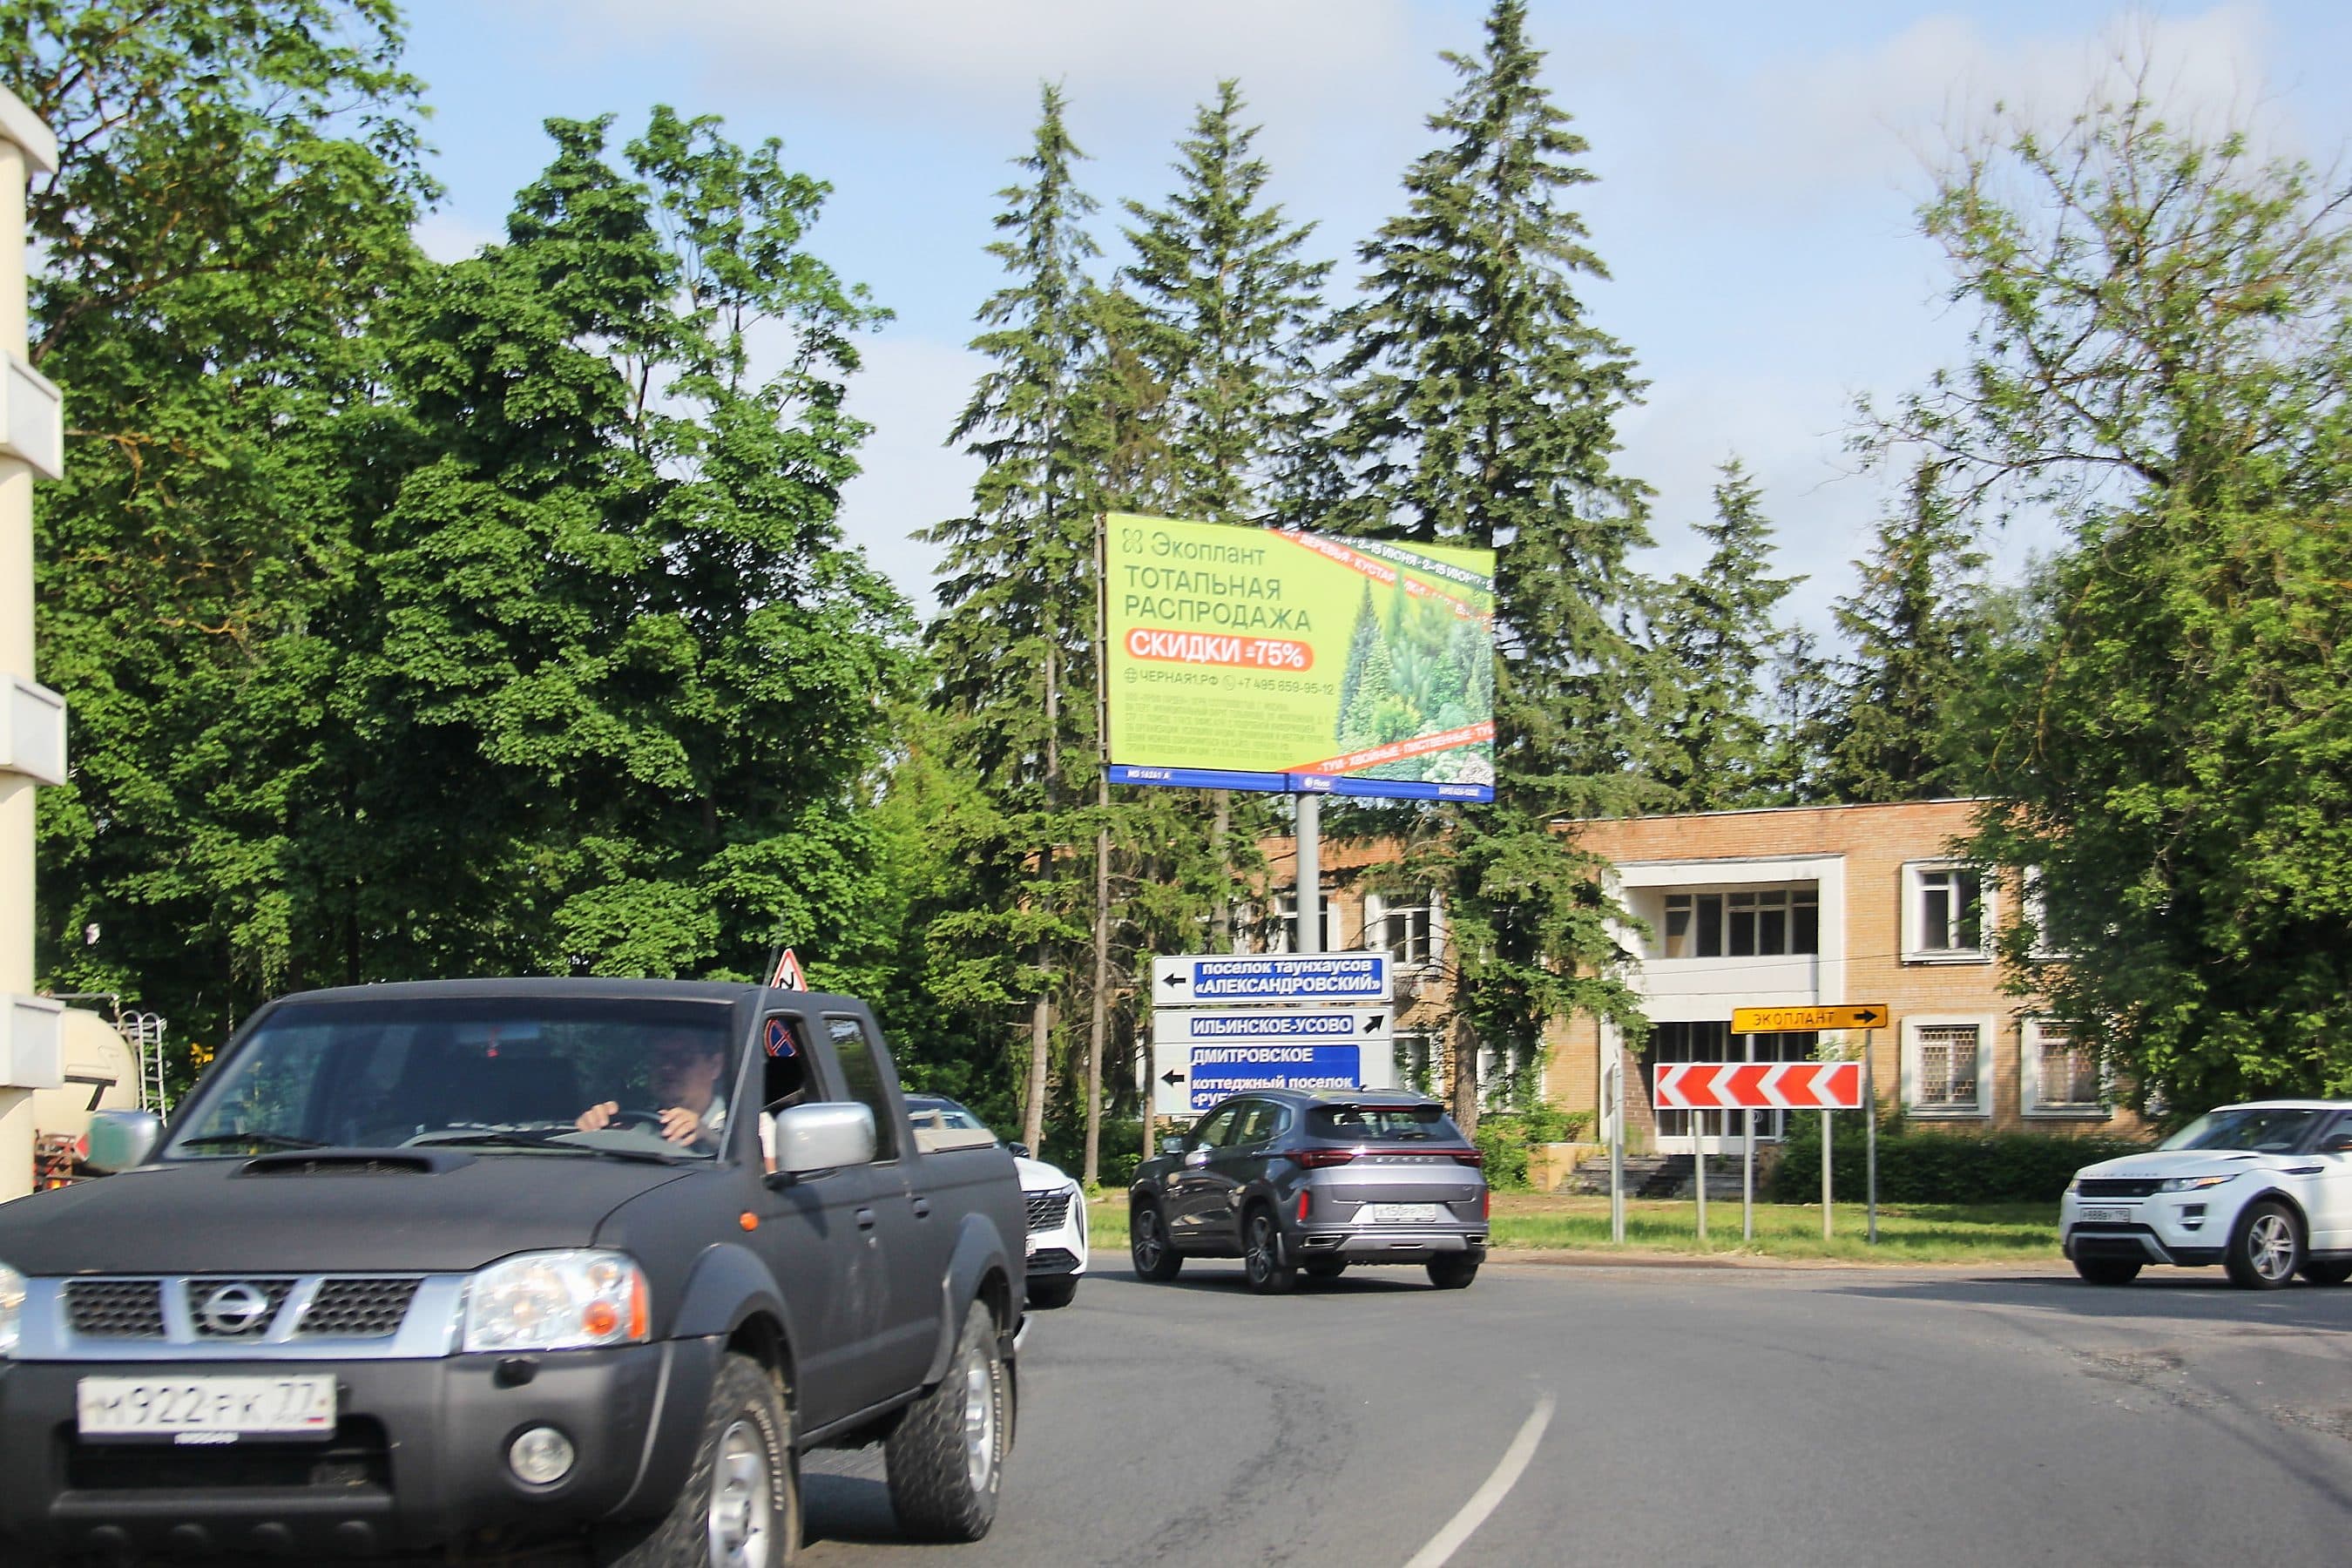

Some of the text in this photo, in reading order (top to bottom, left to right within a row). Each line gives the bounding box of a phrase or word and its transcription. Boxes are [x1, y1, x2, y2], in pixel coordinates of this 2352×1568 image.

[1151, 531, 1266, 565] Экоплант
[1125, 564, 1281, 600] ТОТАЛЬНАЯ
[1125, 594, 1312, 632] РАСПРОДАЖА
[1130, 630, 1241, 664] СКИДКИ
[1202, 960, 1373, 977] поселок таунхаусов
[1194, 975, 1381, 995] «АЛЕКСАНДРОВСКИЙ»
[1193, 1017, 1353, 1034] ИЛЬИНСКОЕ-УСОВО
[1752, 1011, 1835, 1026] ЭКОПЛАНТ
[1191, 1048, 1315, 1066] ДМИТРОВСКОЕ
[1192, 1075, 1354, 1092] коттеджный поселок
